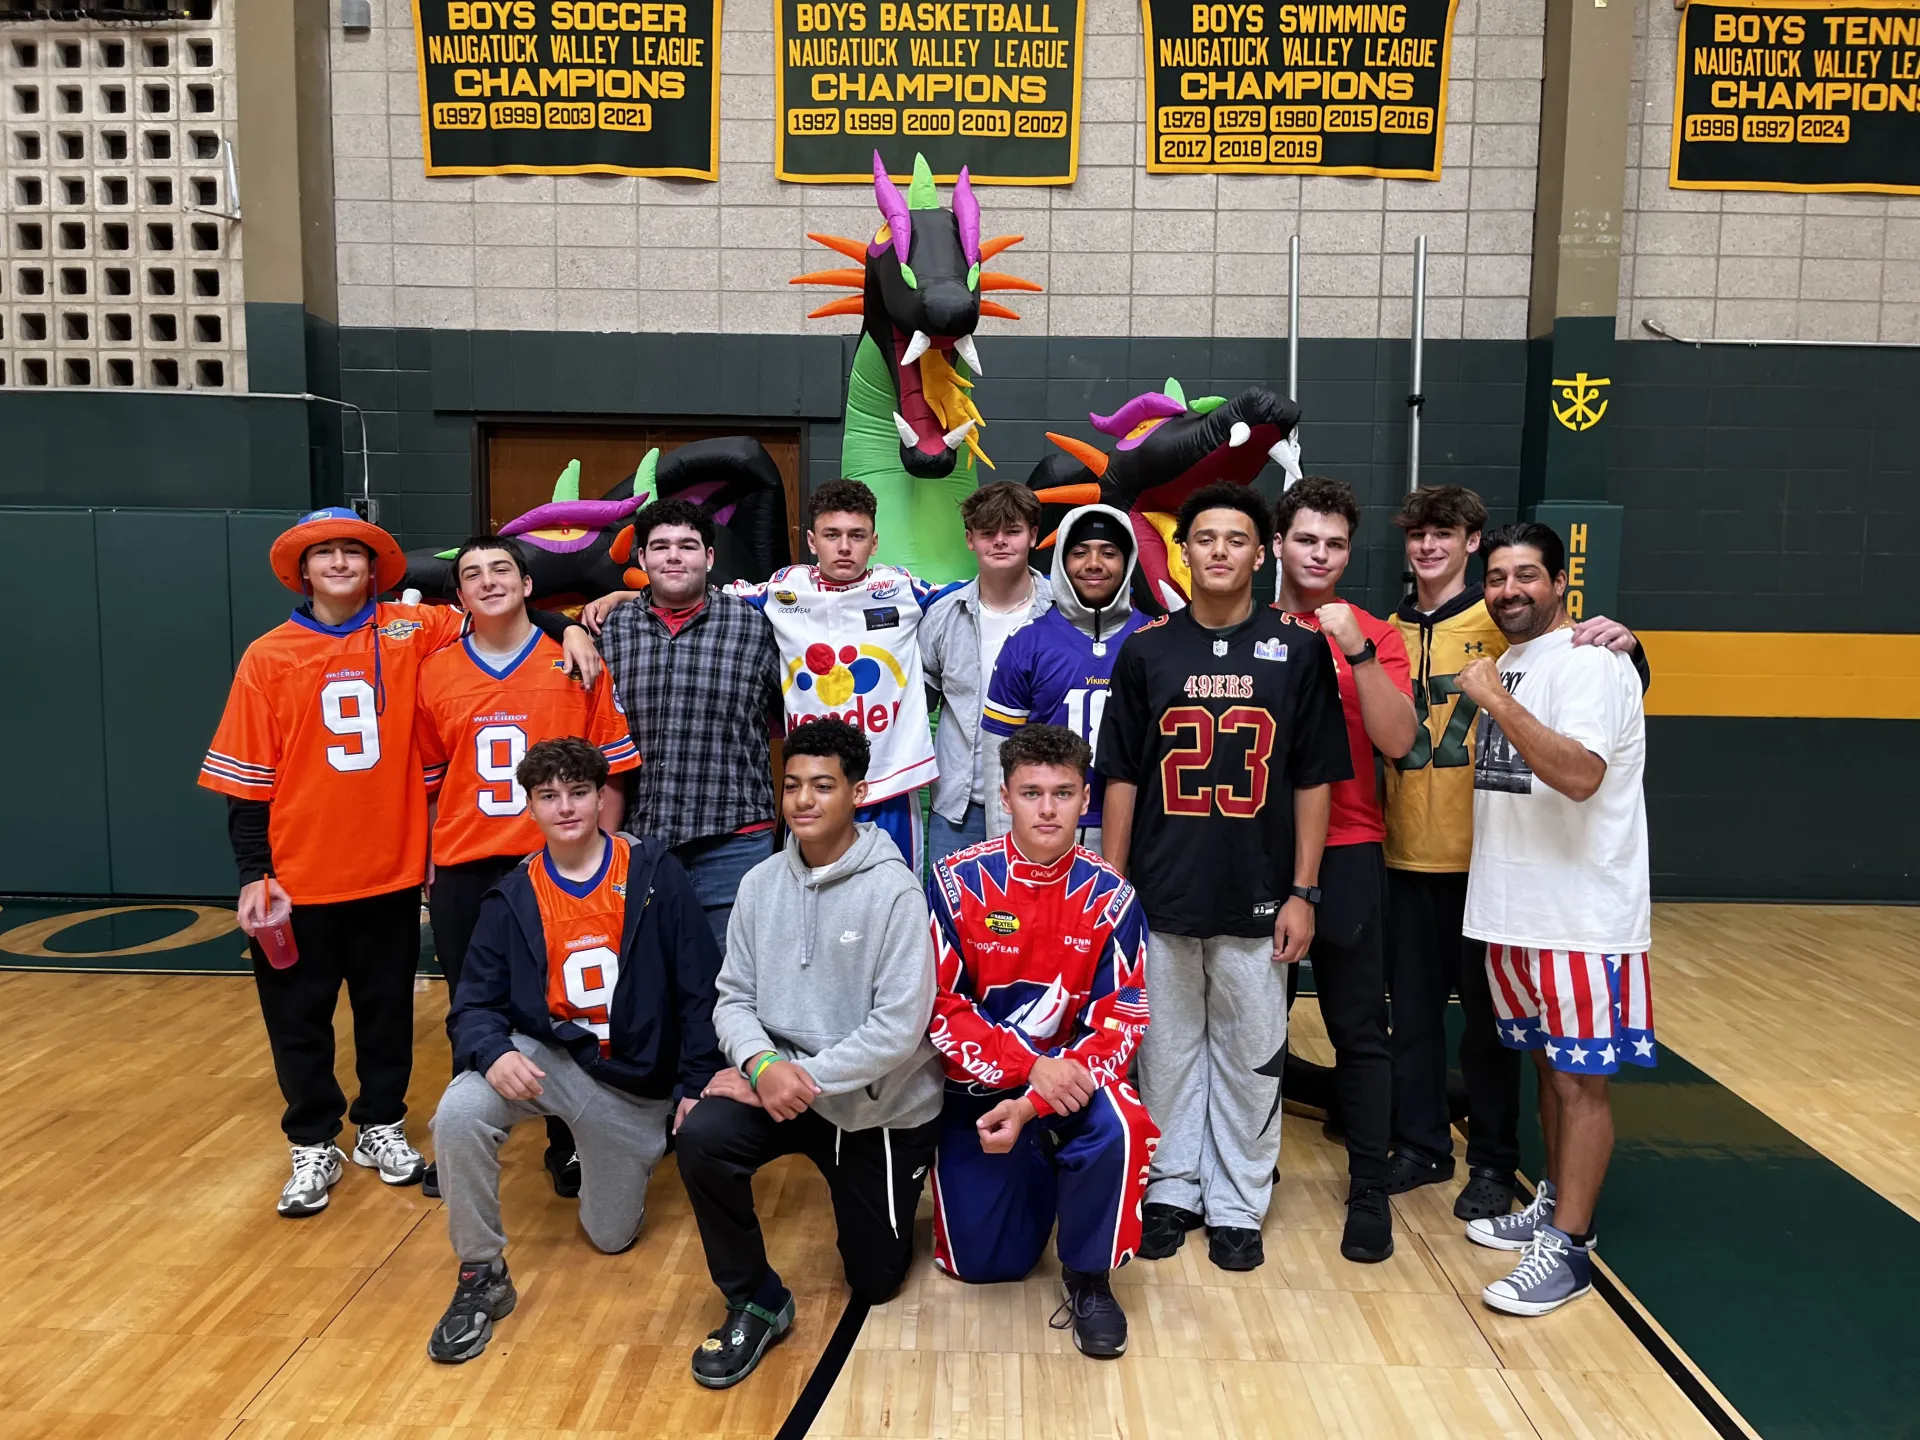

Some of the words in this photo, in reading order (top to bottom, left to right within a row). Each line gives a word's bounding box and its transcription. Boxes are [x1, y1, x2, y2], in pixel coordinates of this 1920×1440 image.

[449, 1, 536, 30] BOYS
[551, 1, 686, 33] SOCCER
[797, 2, 866, 32] BOYS
[880, 3, 1059, 33] BASKETBALL
[1192, 4, 1264, 33] BOYS
[1279, 4, 1407, 34] SWIMMING
[1714, 14, 1806, 45] BOYS
[429, 34, 538, 65] NAUGATUCK
[551, 35, 620, 64] VALLEY
[633, 36, 704, 67] LEAGUE
[788, 37, 898, 67] NAUGATUCK
[910, 38, 981, 67] VALLEY
[994, 40, 1069, 69] LEAGUE
[1159, 37, 1269, 67] NAUGATUCK
[1282, 38, 1353, 67] VALLEY
[1364, 38, 1438, 68] LEAGUE
[1694, 46, 1801, 77] NAUGATUCK
[1813, 50, 1882, 79] VALLEY
[454, 68, 686, 99] CHAMPIONS
[811, 72, 1047, 103] CHAMPIONS
[1180, 71, 1414, 101] CHAMPIONS
[1711, 80, 1920, 112] CHAMPION
[438, 108, 481, 125] 1997
[495, 107, 538, 124] 1999
[549, 107, 591, 125] 2003
[604, 108, 646, 126] 2021
[793, 113, 837, 130] 1997
[850, 113, 893, 130] 1999
[907, 114, 950, 131] 2000
[962, 115, 1006, 132] 2001
[1018, 116, 1064, 133] 2007
[1163, 111, 1206, 129] 1978
[1218, 110, 1261, 128] 1979
[1275, 110, 1318, 128] 1980
[1329, 109, 1373, 127] 2015
[1384, 111, 1429, 129] 2016
[1690, 119, 1735, 137] 1996
[1747, 120, 1790, 138] 1997
[1801, 120, 1845, 138] 2024
[1164, 140, 1206, 158] 2017
[1219, 140, 1262, 158] 2018
[1274, 140, 1318, 158] 2019
[866, 580, 895, 591] DENNIT
[878, 587, 897, 597] Racing
[778, 606, 811, 614] GOODYEAR
[325, 670, 365, 678] WATERBOY
[1184, 675, 1253, 698] 49ERS
[321, 678, 381, 772] 9
[474, 723, 529, 818] 9
[1159, 706, 1276, 818] 23
[939, 865, 960, 904] sparco
[1030, 869, 1043, 877] Old
[992, 919, 1014, 928] NEXTEL
